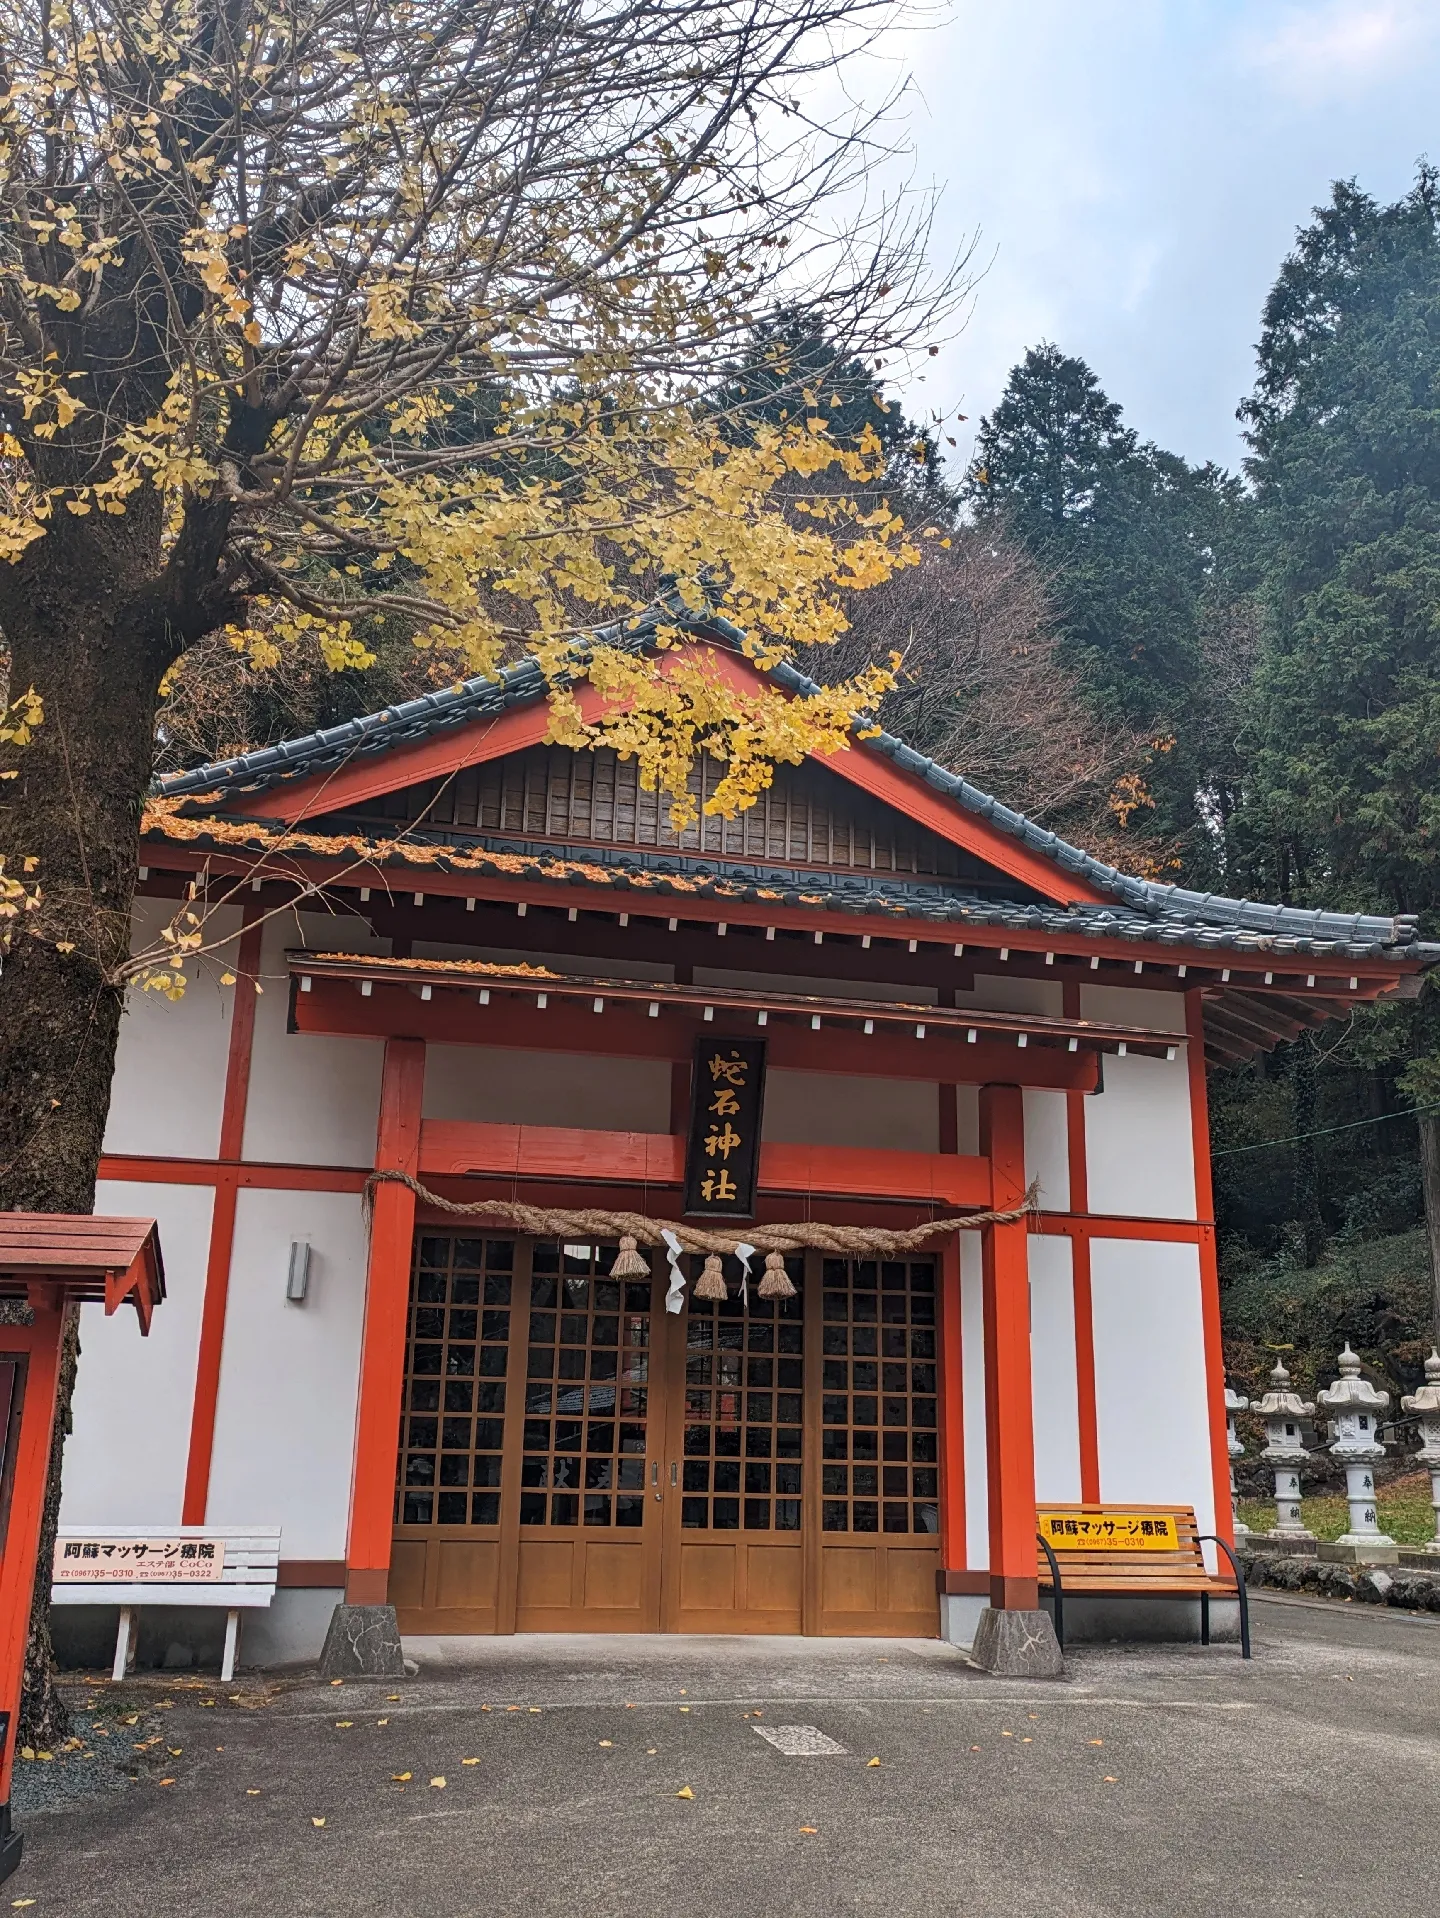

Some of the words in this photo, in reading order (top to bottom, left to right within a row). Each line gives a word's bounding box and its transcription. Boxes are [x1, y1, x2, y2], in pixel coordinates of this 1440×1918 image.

[701, 1051, 748, 1201] 蛇石神社
[1362, 1475, 1376, 1523] 奉納
[1050, 1519, 1169, 1537] 阿蘇マッサージ療院
[63, 1542, 216, 1559] 阿蘇マッサージ療院
[136, 1560, 176, 1569] エステ部
[180, 1560, 213, 1568] CoCo
